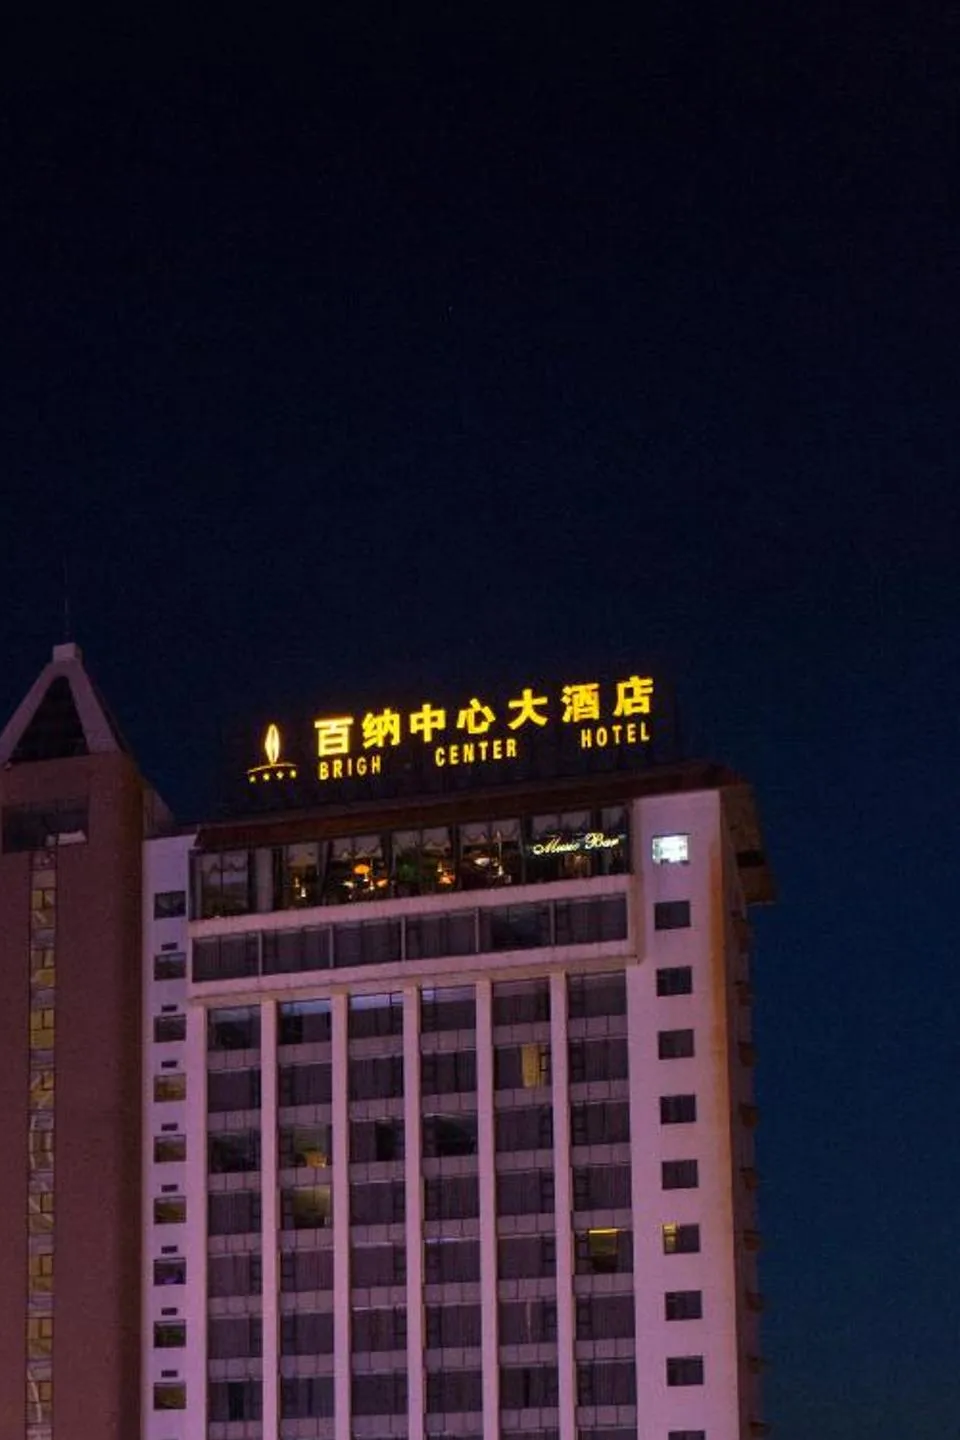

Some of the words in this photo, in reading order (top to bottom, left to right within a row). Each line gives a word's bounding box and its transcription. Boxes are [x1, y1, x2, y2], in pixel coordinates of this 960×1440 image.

[314, 675, 654, 757] 百纳中心大酒店
[319, 755, 382, 780] BRIGH
[435, 738, 518, 768] CENTER
[581, 722, 651, 750] HOTEL
